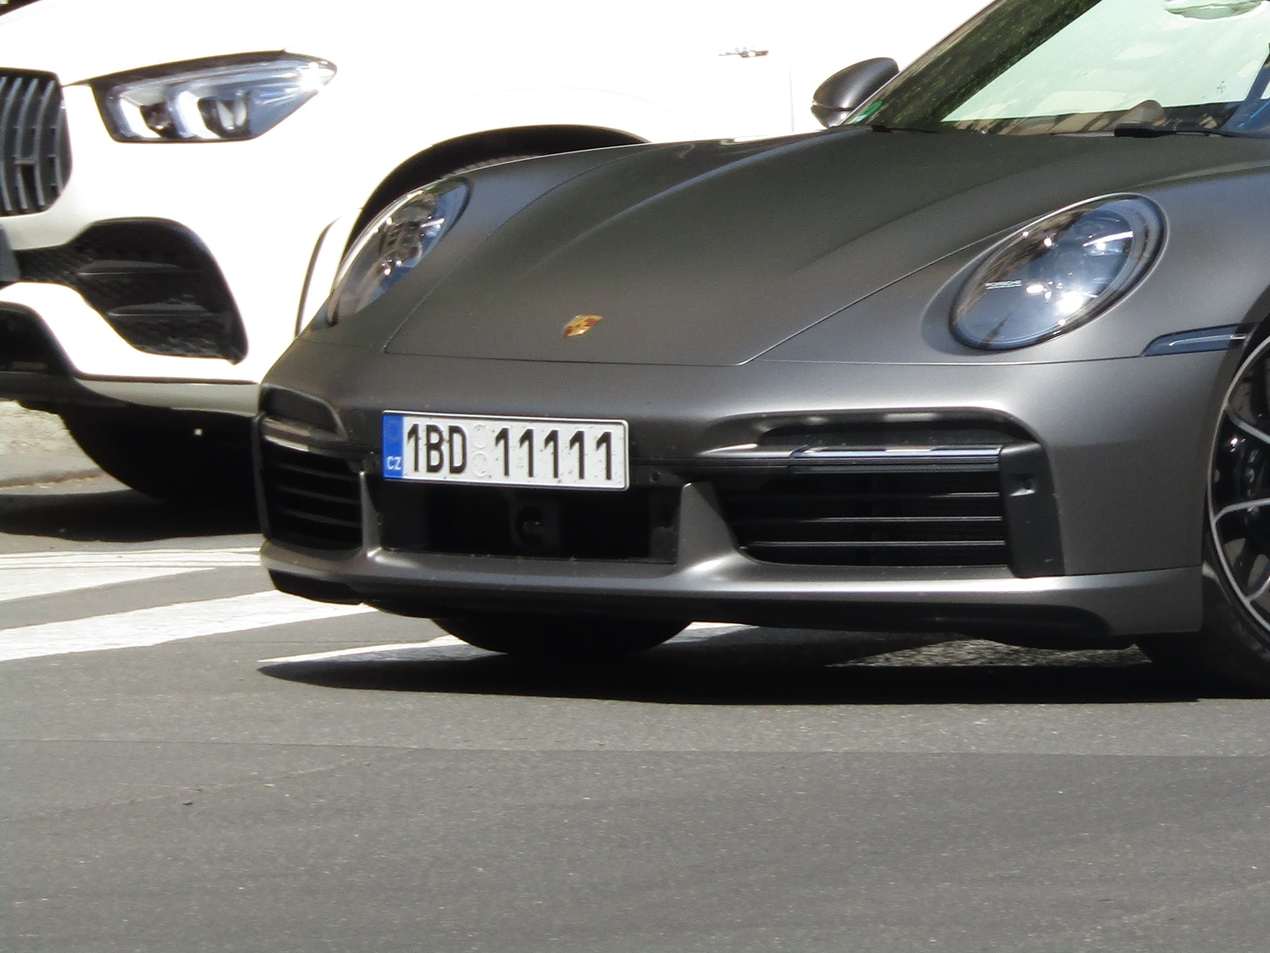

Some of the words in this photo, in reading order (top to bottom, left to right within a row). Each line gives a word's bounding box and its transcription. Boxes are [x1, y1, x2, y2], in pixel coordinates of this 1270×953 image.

[387, 456, 401, 470] CZ
[407, 424, 468, 474] 1BD
[495, 427, 613, 481] 11111
